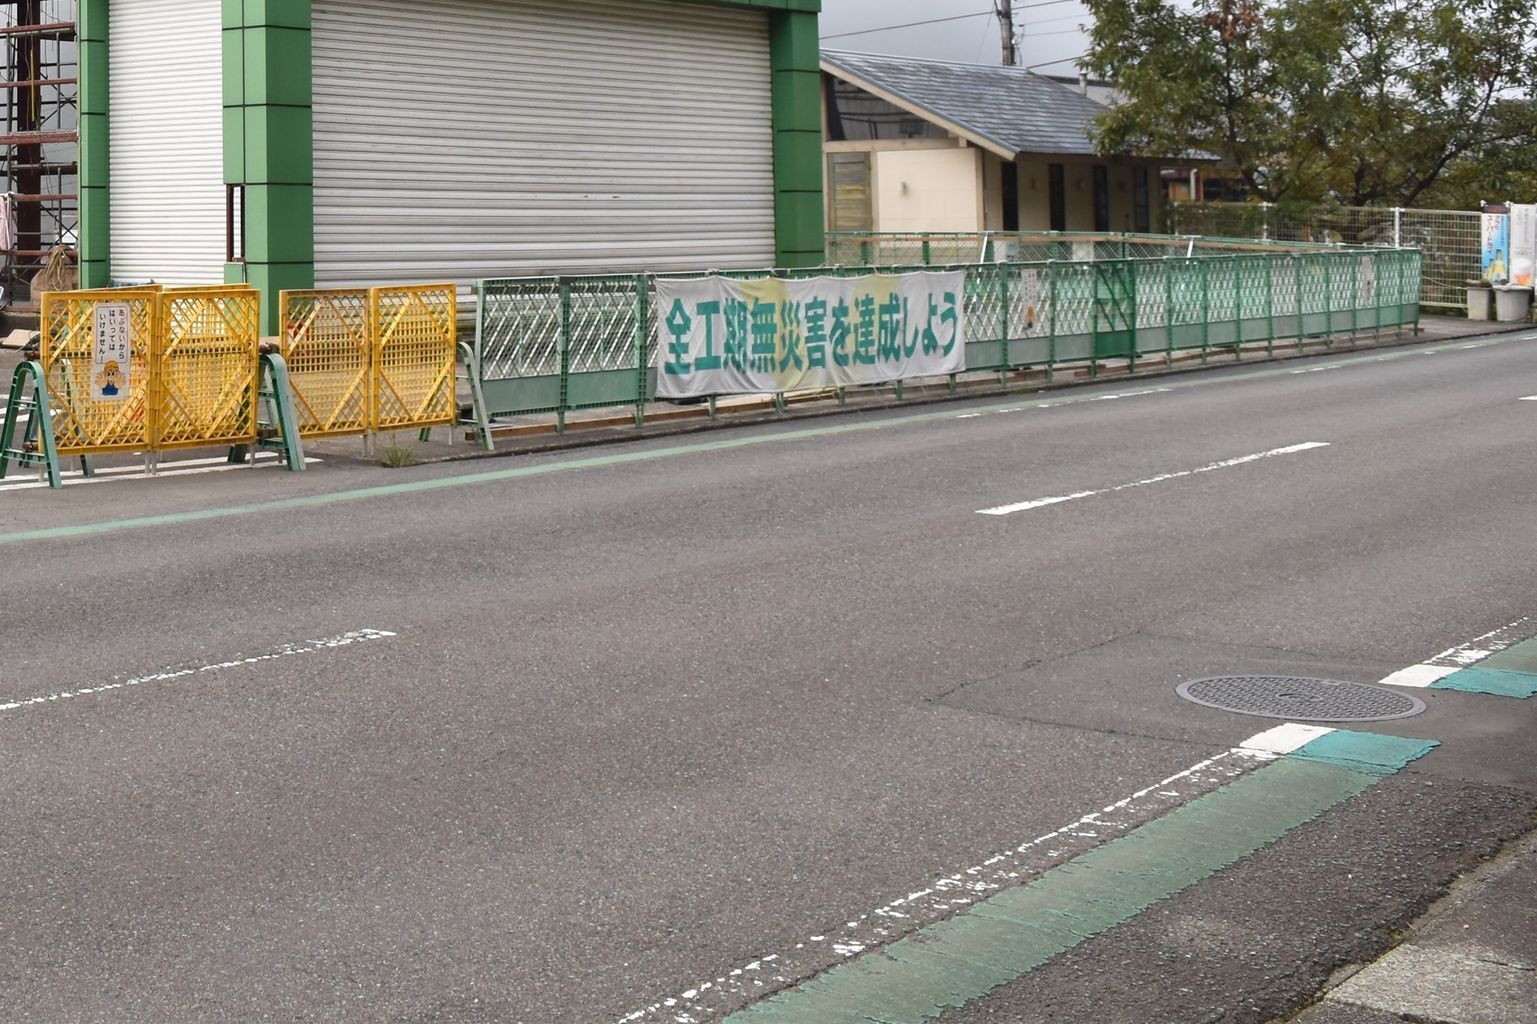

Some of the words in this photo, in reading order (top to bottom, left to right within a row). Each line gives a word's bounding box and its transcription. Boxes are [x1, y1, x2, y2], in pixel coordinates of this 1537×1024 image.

[108, 309, 116, 351] はいっては
[118, 309, 126, 360] あぶないから
[664, 290, 958, 376] 全工期無災害を達成しよう
